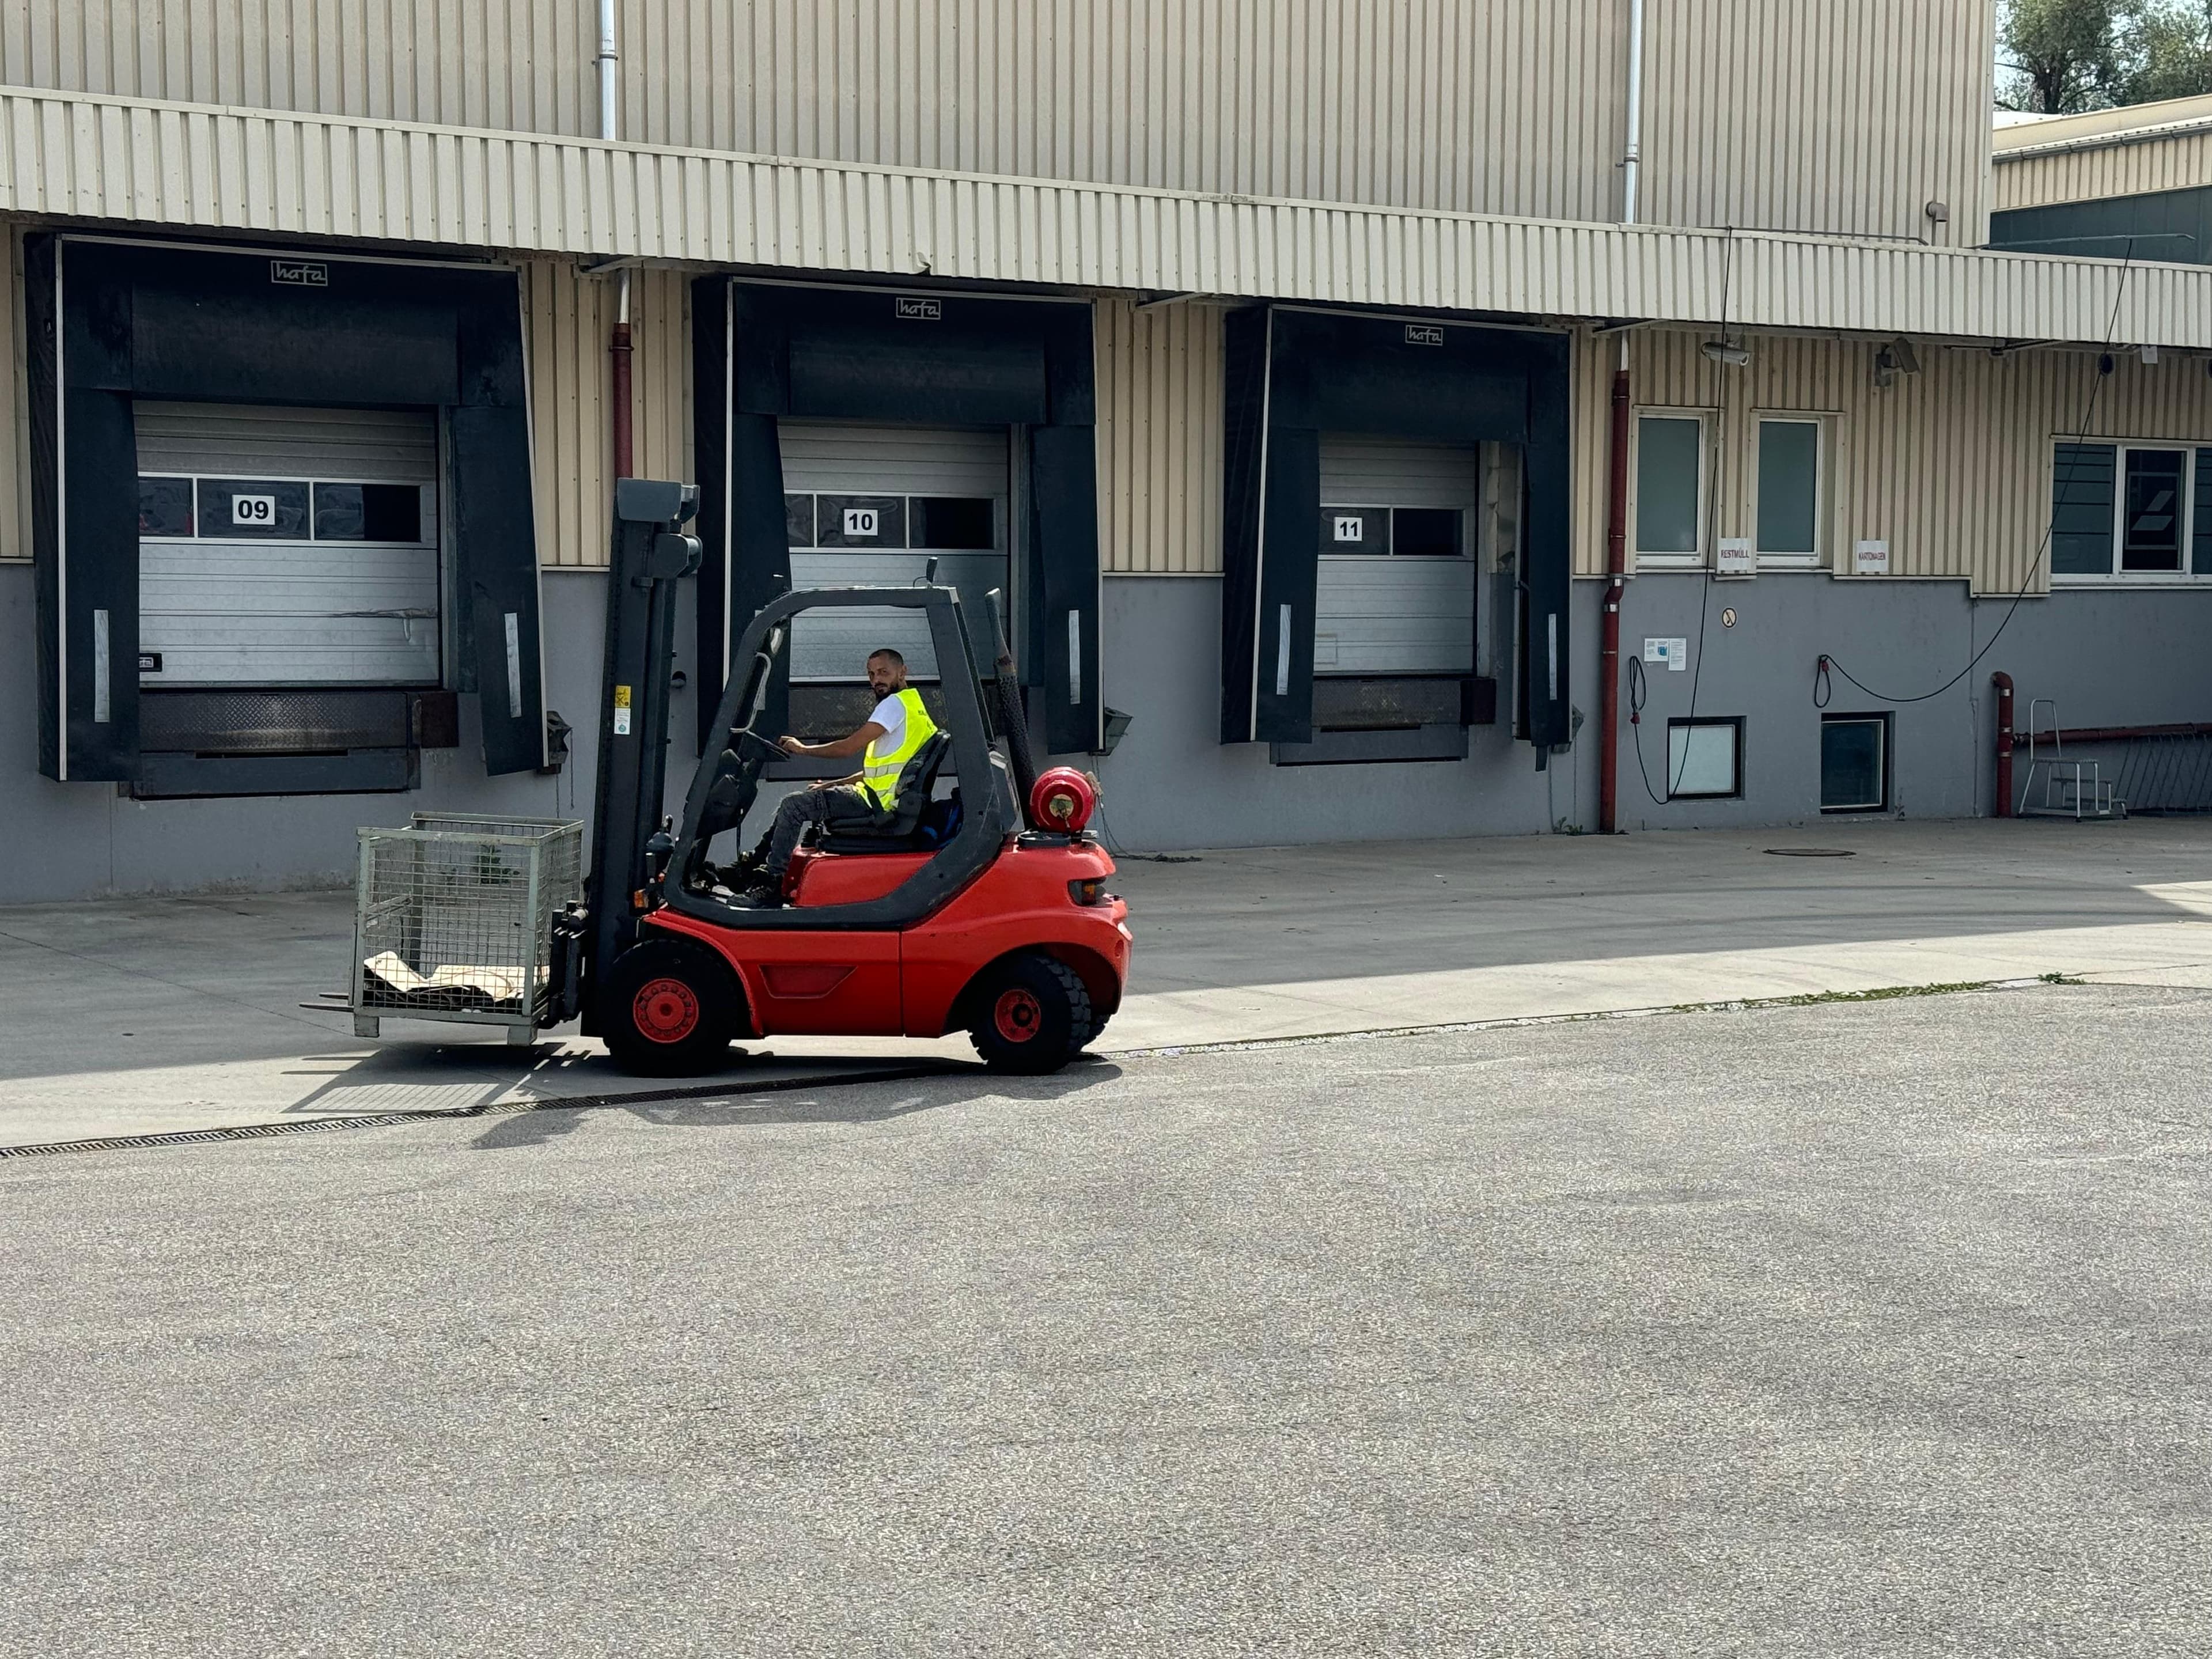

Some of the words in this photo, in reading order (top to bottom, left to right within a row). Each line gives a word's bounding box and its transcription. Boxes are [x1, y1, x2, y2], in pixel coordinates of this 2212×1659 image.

[276, 262, 327, 285] hafa
[900, 299, 940, 318] hafa
[1408, 326, 1442, 344] hafa
[238, 499, 269, 520] 09
[849, 513, 873, 531] 10
[1340, 521, 1358, 537] 11
